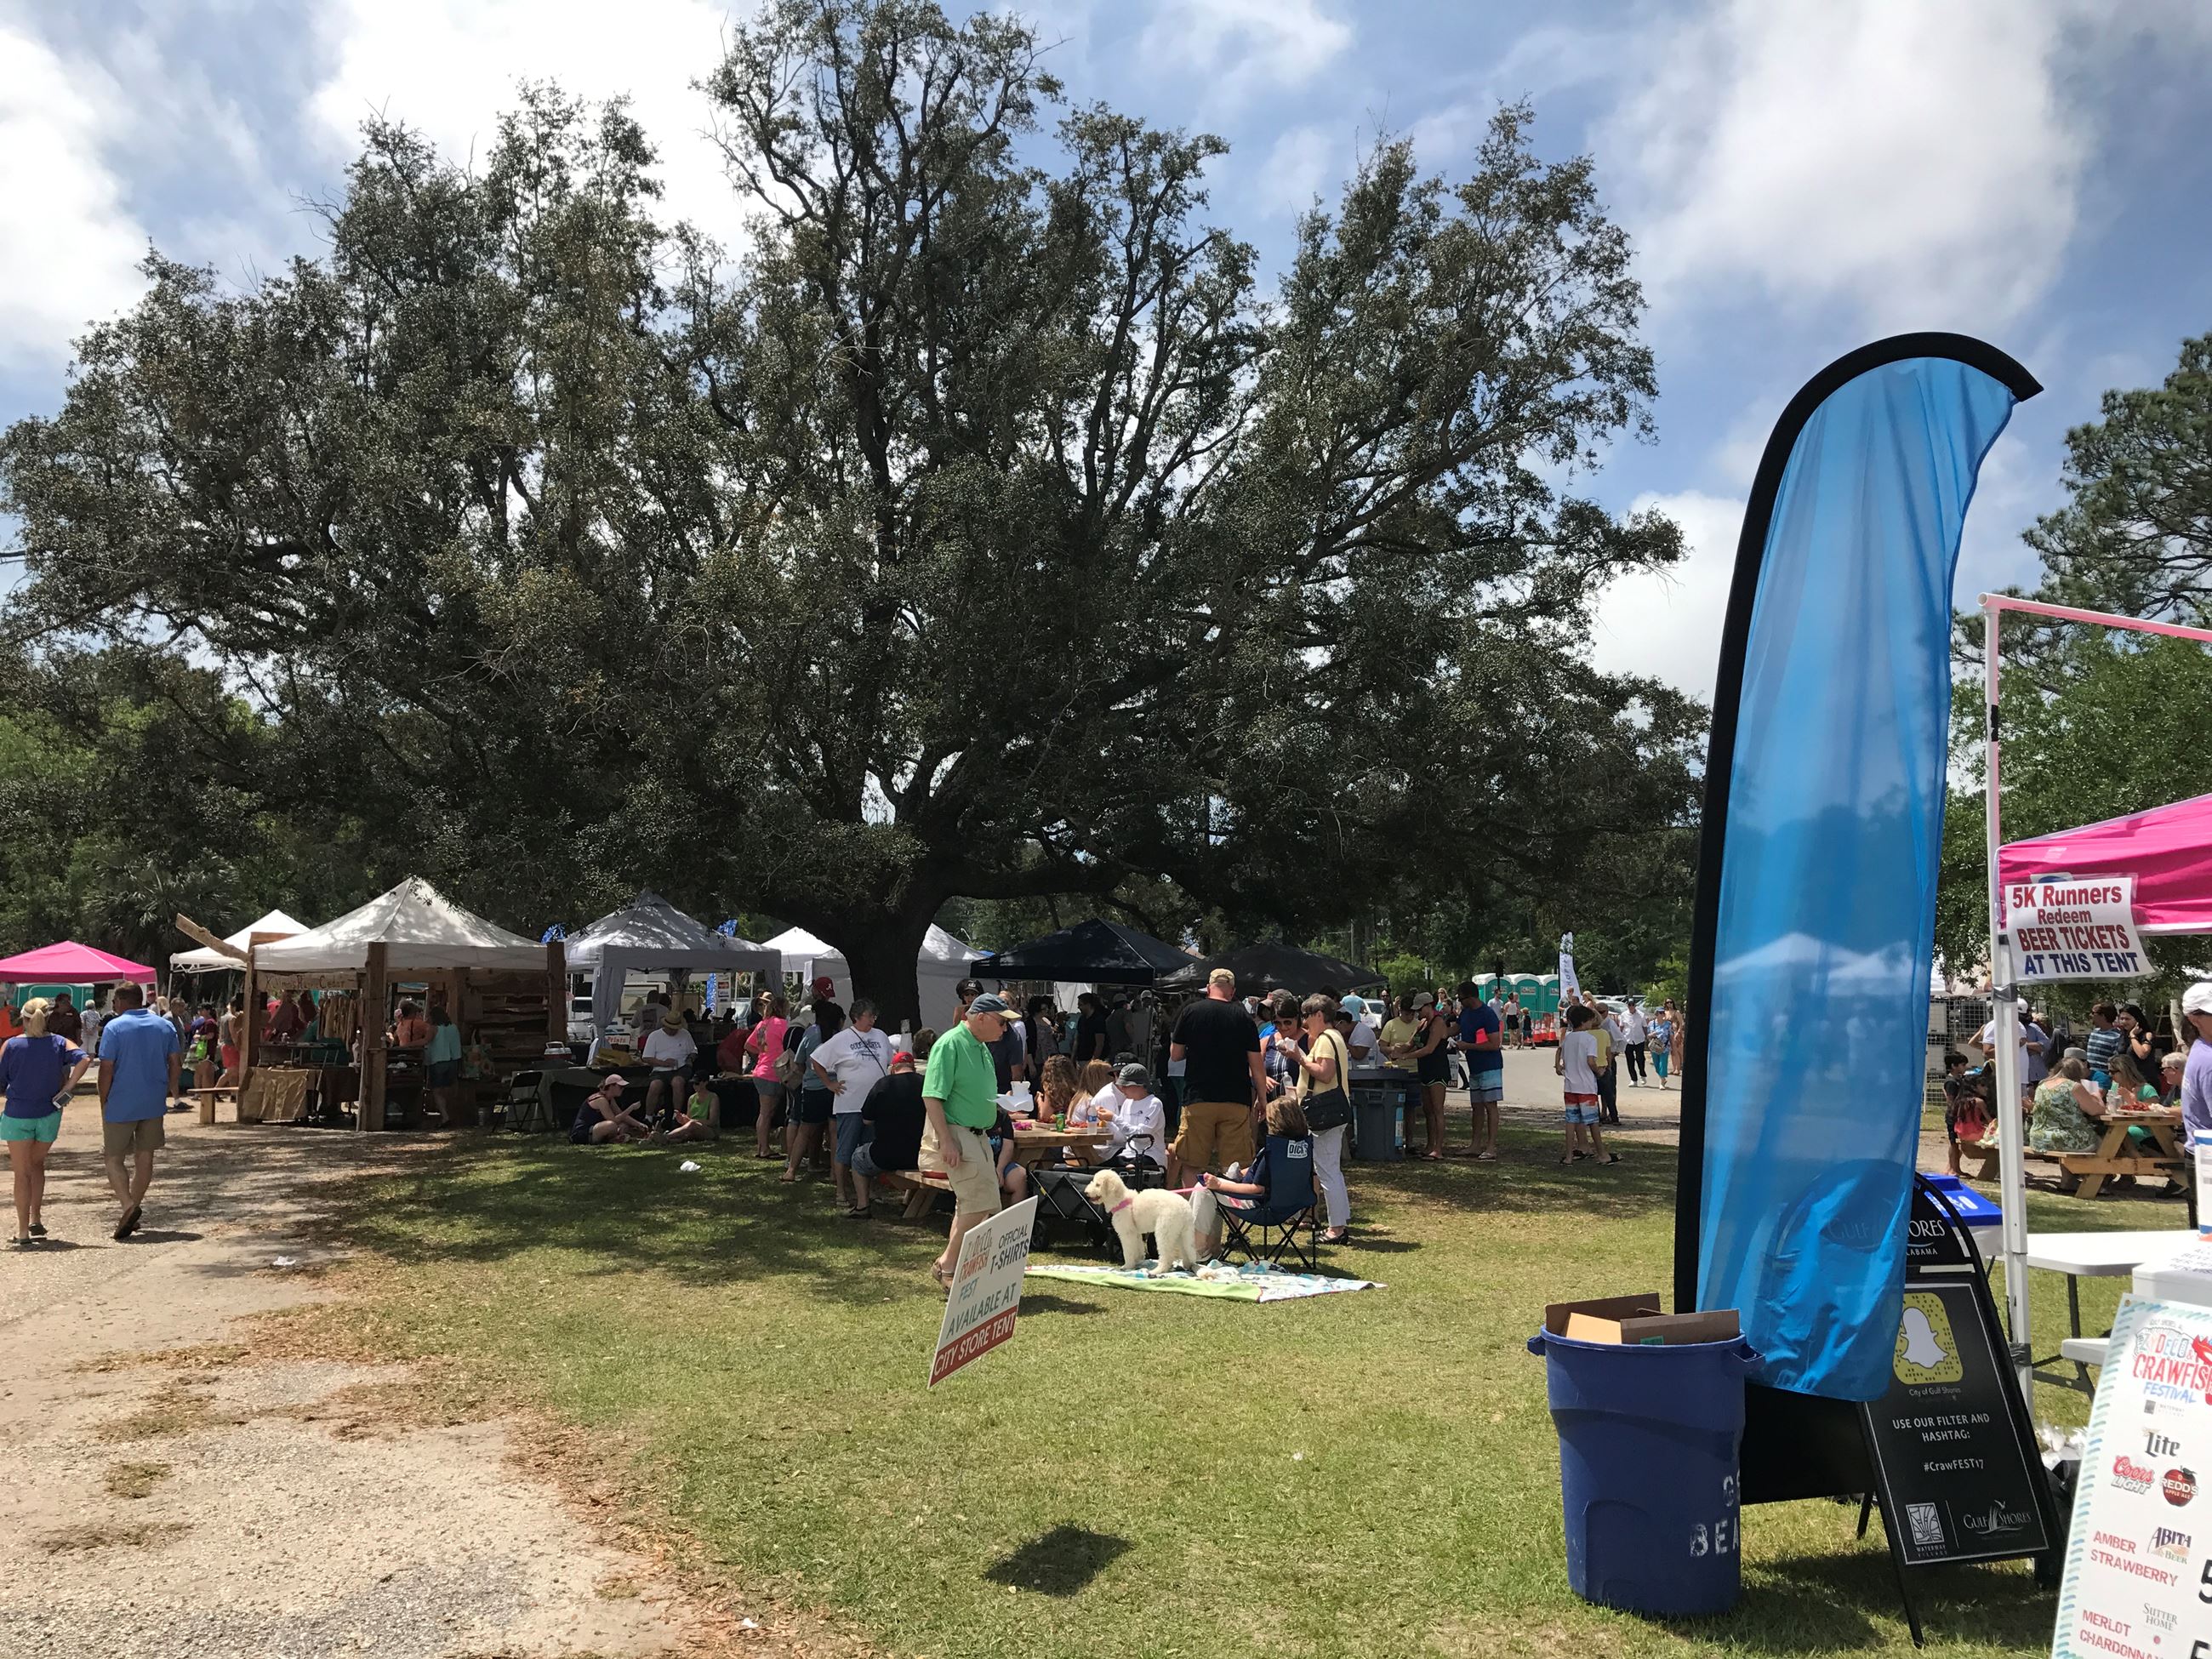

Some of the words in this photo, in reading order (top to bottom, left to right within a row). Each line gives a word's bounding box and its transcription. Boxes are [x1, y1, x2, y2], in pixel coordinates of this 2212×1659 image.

[2012, 887, 2037, 909] 5K
[2043, 885, 2123, 907] Runners
[2037, 908, 2092, 925] Redeem
[2016, 927, 2061, 952] BEER
[2059, 924, 2130, 950] TICKETS
[2025, 954, 2044, 975] AT
[2049, 953, 2091, 973] THIS
[2092, 952, 2140, 972] TENT
[998, 1223, 1028, 1249] OFFICIAL
[1907, 1219, 1946, 1237] ORES
[989, 1238, 1029, 1274] T-SHIRTS
[958, 1276, 979, 1304] FEST
[946, 1287, 1001, 1340] AVAILABLE
[1001, 1282, 1017, 1306] AT
[933, 1344, 958, 1377] CITY
[958, 1328, 989, 1361] STORE
[992, 1311, 1016, 1341] TENT
[1908, 1388, 1921, 1397] City
[1922, 1387, 1928, 1395] of
[2143, 1382, 2197, 1403] FESTIVAL
[1892, 1418, 1912, 1429] USE
[1913, 1417, 1935, 1428] OUR
[1936, 1415, 1969, 1426] FILTER
[1971, 1413, 1990, 1423] AND
[1922, 1429, 1970, 1442] HASHTAG:
[2145, 1431, 2181, 1457] Lite
[1924, 1458, 1984, 1472] #CrawFEST17
[2112, 1455, 2155, 1485] Coors
[2111, 1476, 2151, 1495] LIGHT
[1963, 1514, 1987, 1529] GULF
[2093, 1531, 2136, 1554] AMBER
[2147, 1527, 2192, 1552] ABITA
[2090, 1548, 2179, 1588] STRAWBERRY
[2164, 1550, 2188, 1565] BEER
[2082, 1610, 2131, 1637] MERLOT
[2143, 1603, 2178, 1625] SUTTER
[2146, 1615, 2174, 1631] HOME
[2079, 1629, 2164, 1659] CHARDONNA
